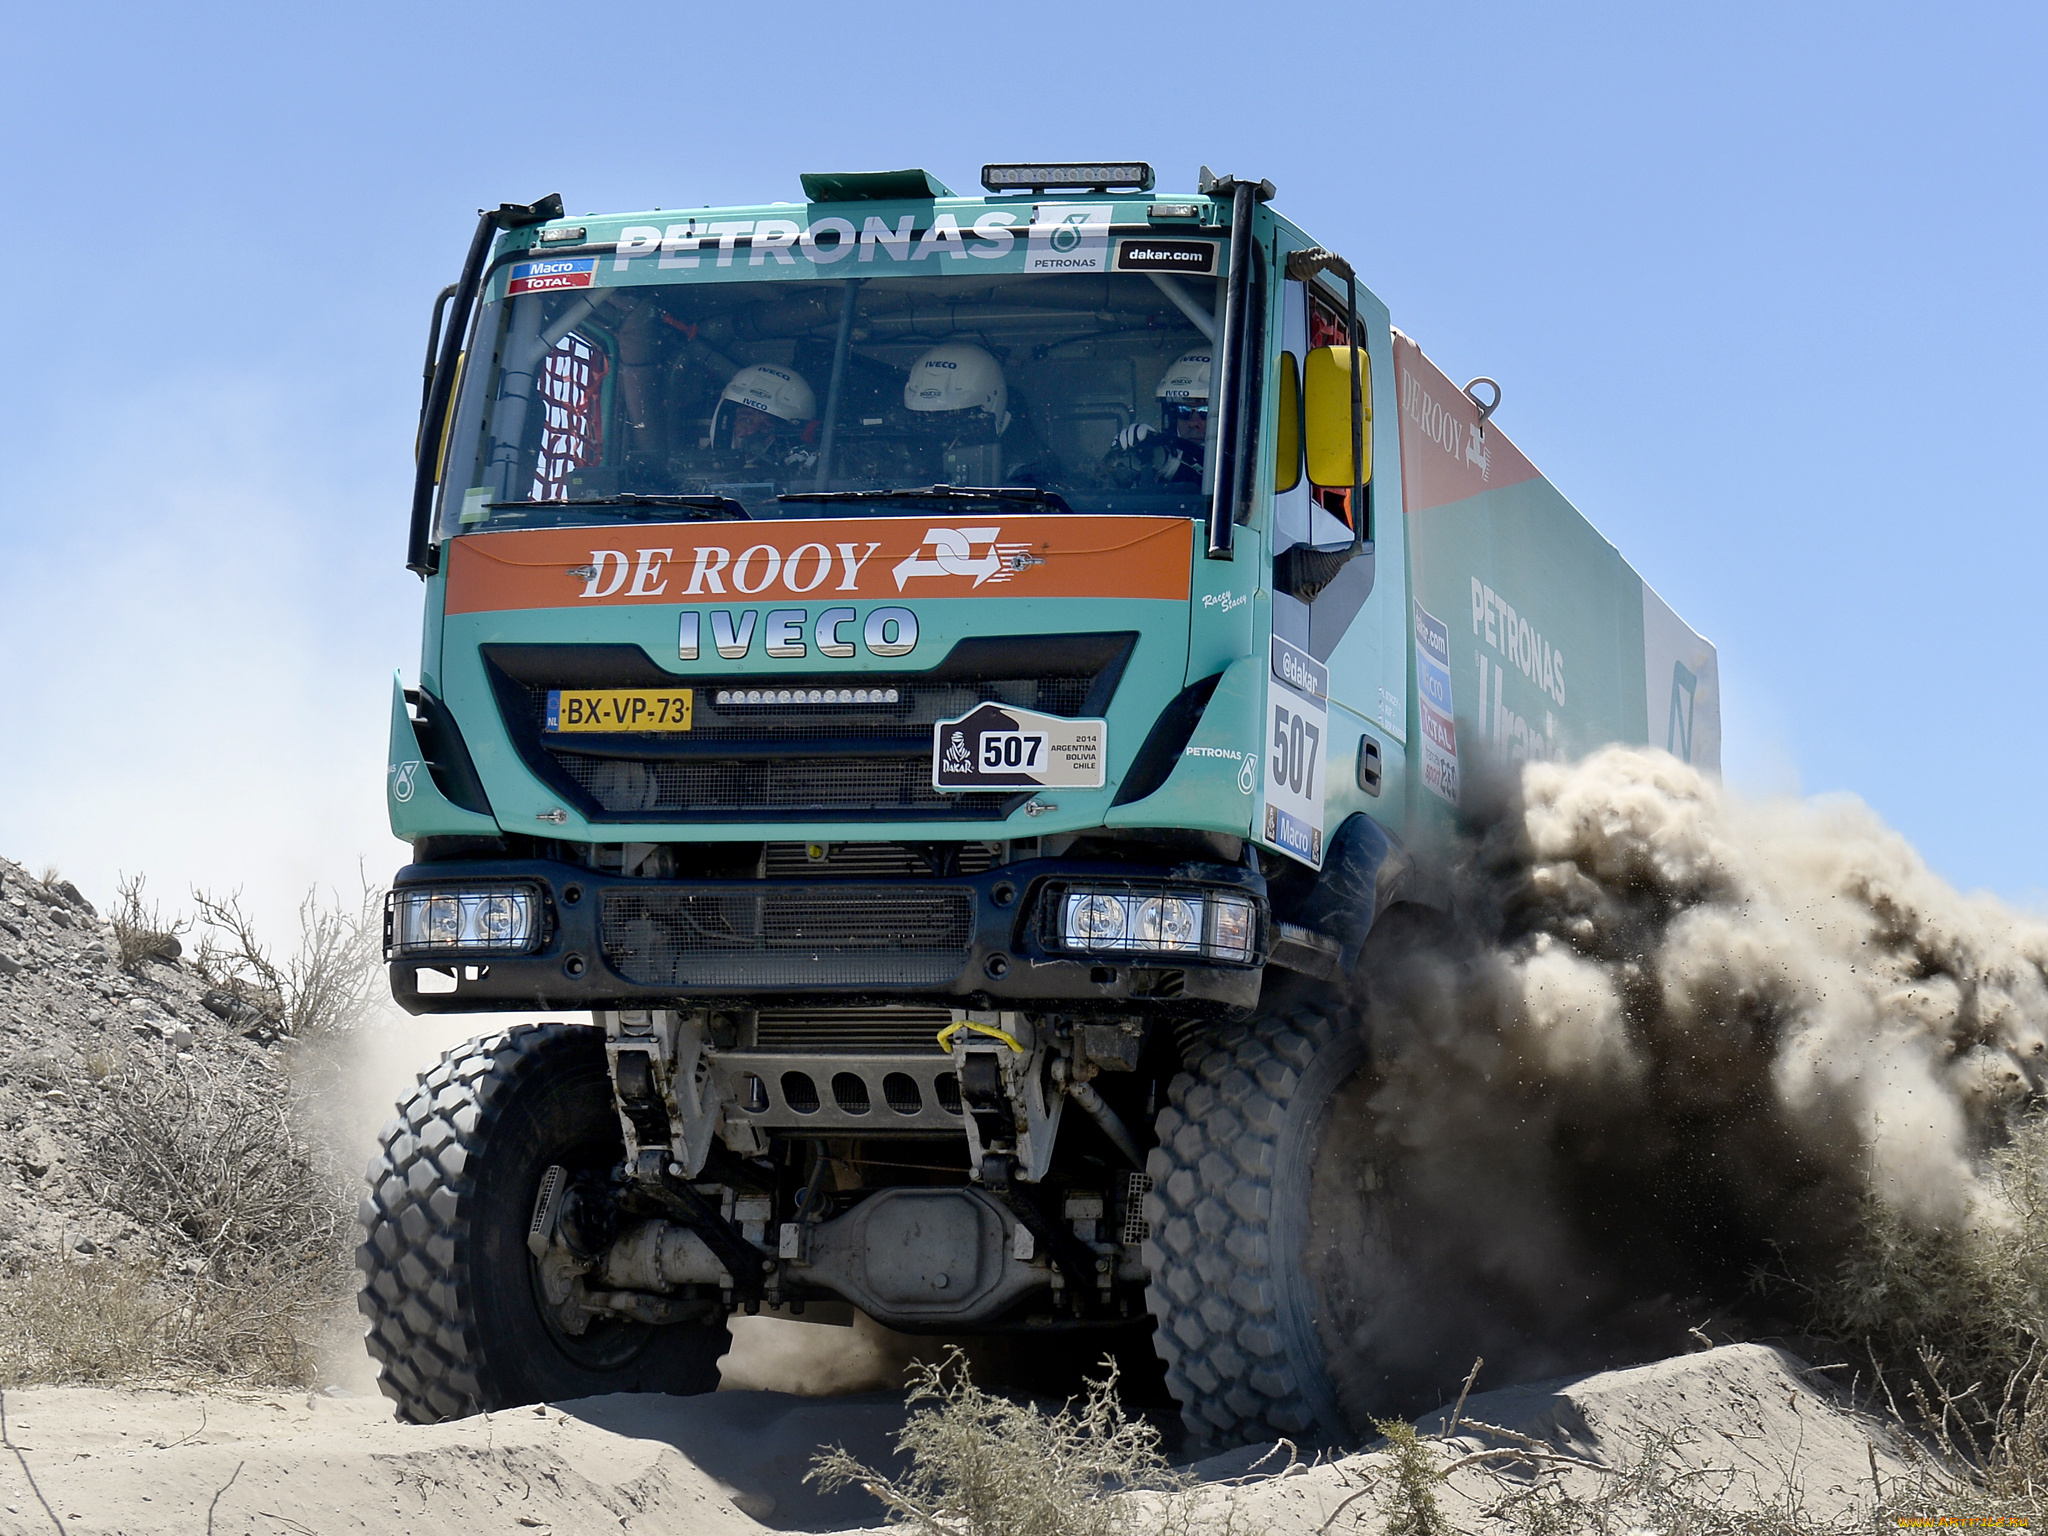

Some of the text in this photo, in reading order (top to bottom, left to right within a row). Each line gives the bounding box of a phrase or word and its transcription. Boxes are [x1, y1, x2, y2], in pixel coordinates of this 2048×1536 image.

[613, 211, 1018, 272] PETRONAS
[1128, 248, 1203, 262] dakar.com
[530, 261, 574, 275] Macro
[1034, 258, 1097, 268] PETRONAS
[525, 277, 572, 289] TOTAL
[925, 361, 957, 370] IVECO
[1180, 355, 1211, 363] IVECO
[758, 366, 791, 381] IVECO
[743, 397, 768, 411] IVECO
[1401, 367, 1462, 461] DE ROOY
[579, 542, 881, 598] DE ROOY
[678, 606, 920, 660] IVECO
[1471, 575, 1566, 707] PETRONAS
[1283, 652, 1318, 694] @dakar
[567, 697, 685, 724] BX-VP-73
[548, 716, 559, 727] NL
[984, 736, 1042, 767] 507
[1051, 744, 1097, 752] ARGENTINA
[1186, 746, 1242, 760] PETRONAS
[1273, 704, 1320, 801] 507
[1065, 753, 1097, 761] BOLIVIA
[1280, 817, 1309, 853] Macro
